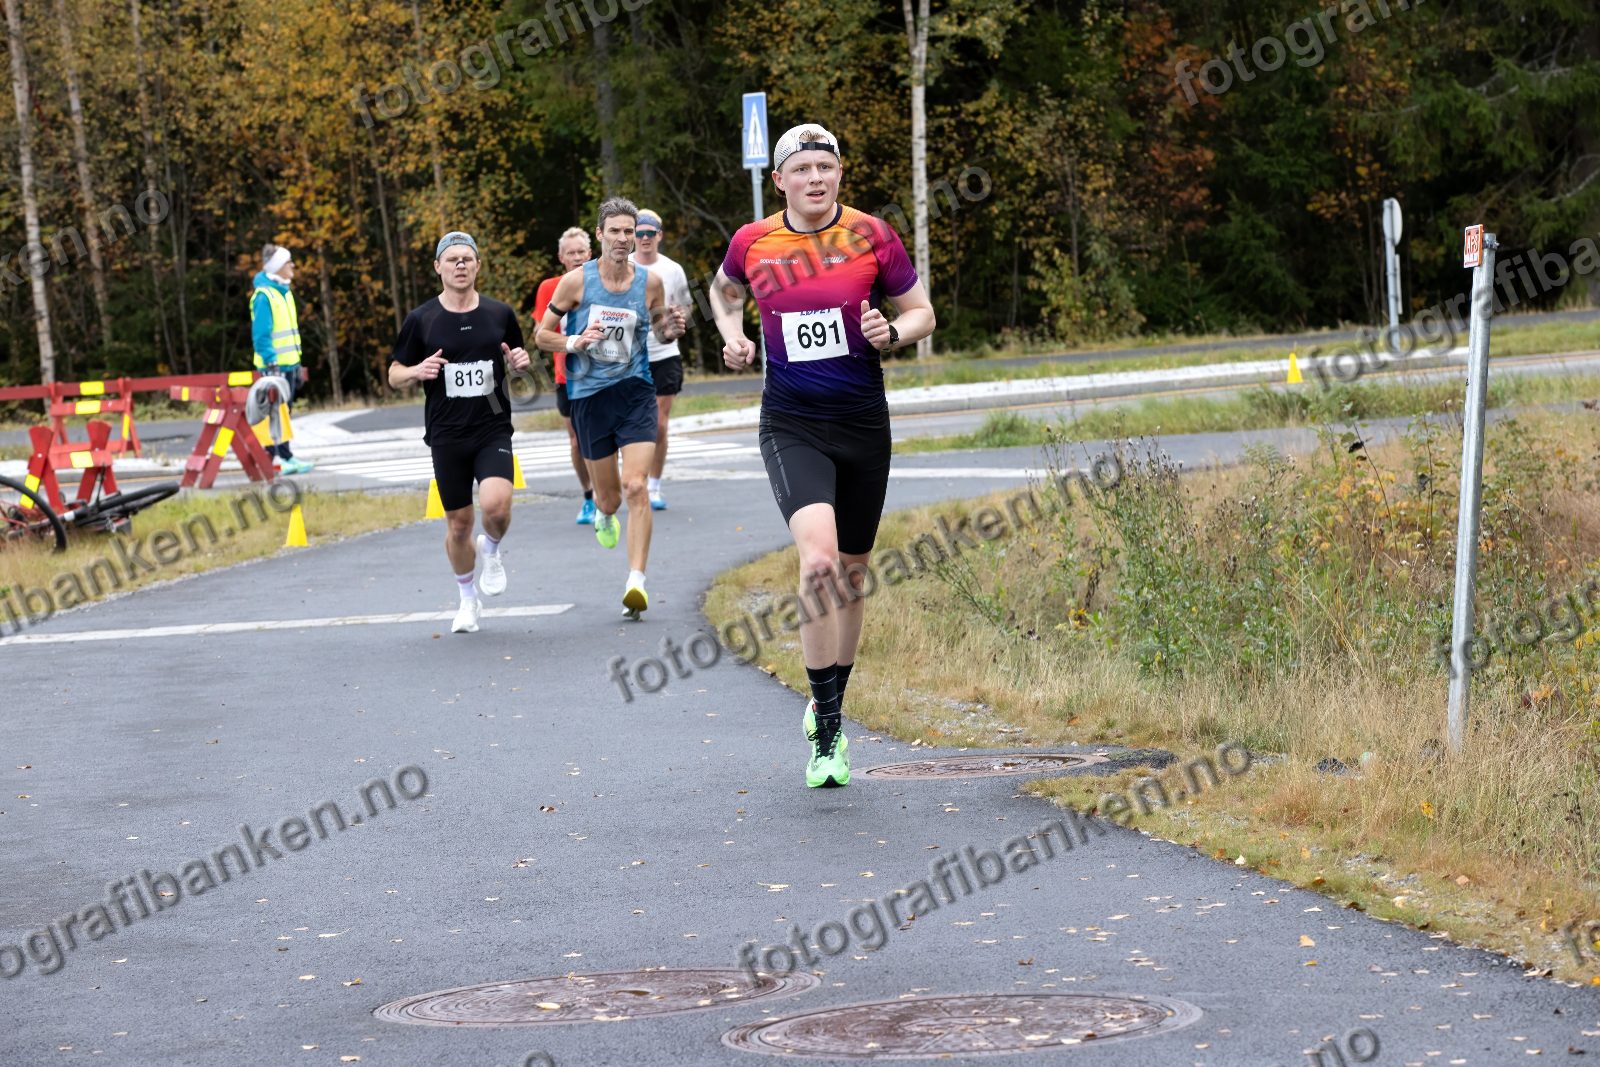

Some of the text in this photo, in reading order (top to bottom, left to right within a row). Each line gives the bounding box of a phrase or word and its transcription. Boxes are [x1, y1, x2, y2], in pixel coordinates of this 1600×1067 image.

[598, 326, 625, 342] 70
[797, 320, 841, 349] 691
[455, 369, 485, 387] 813
